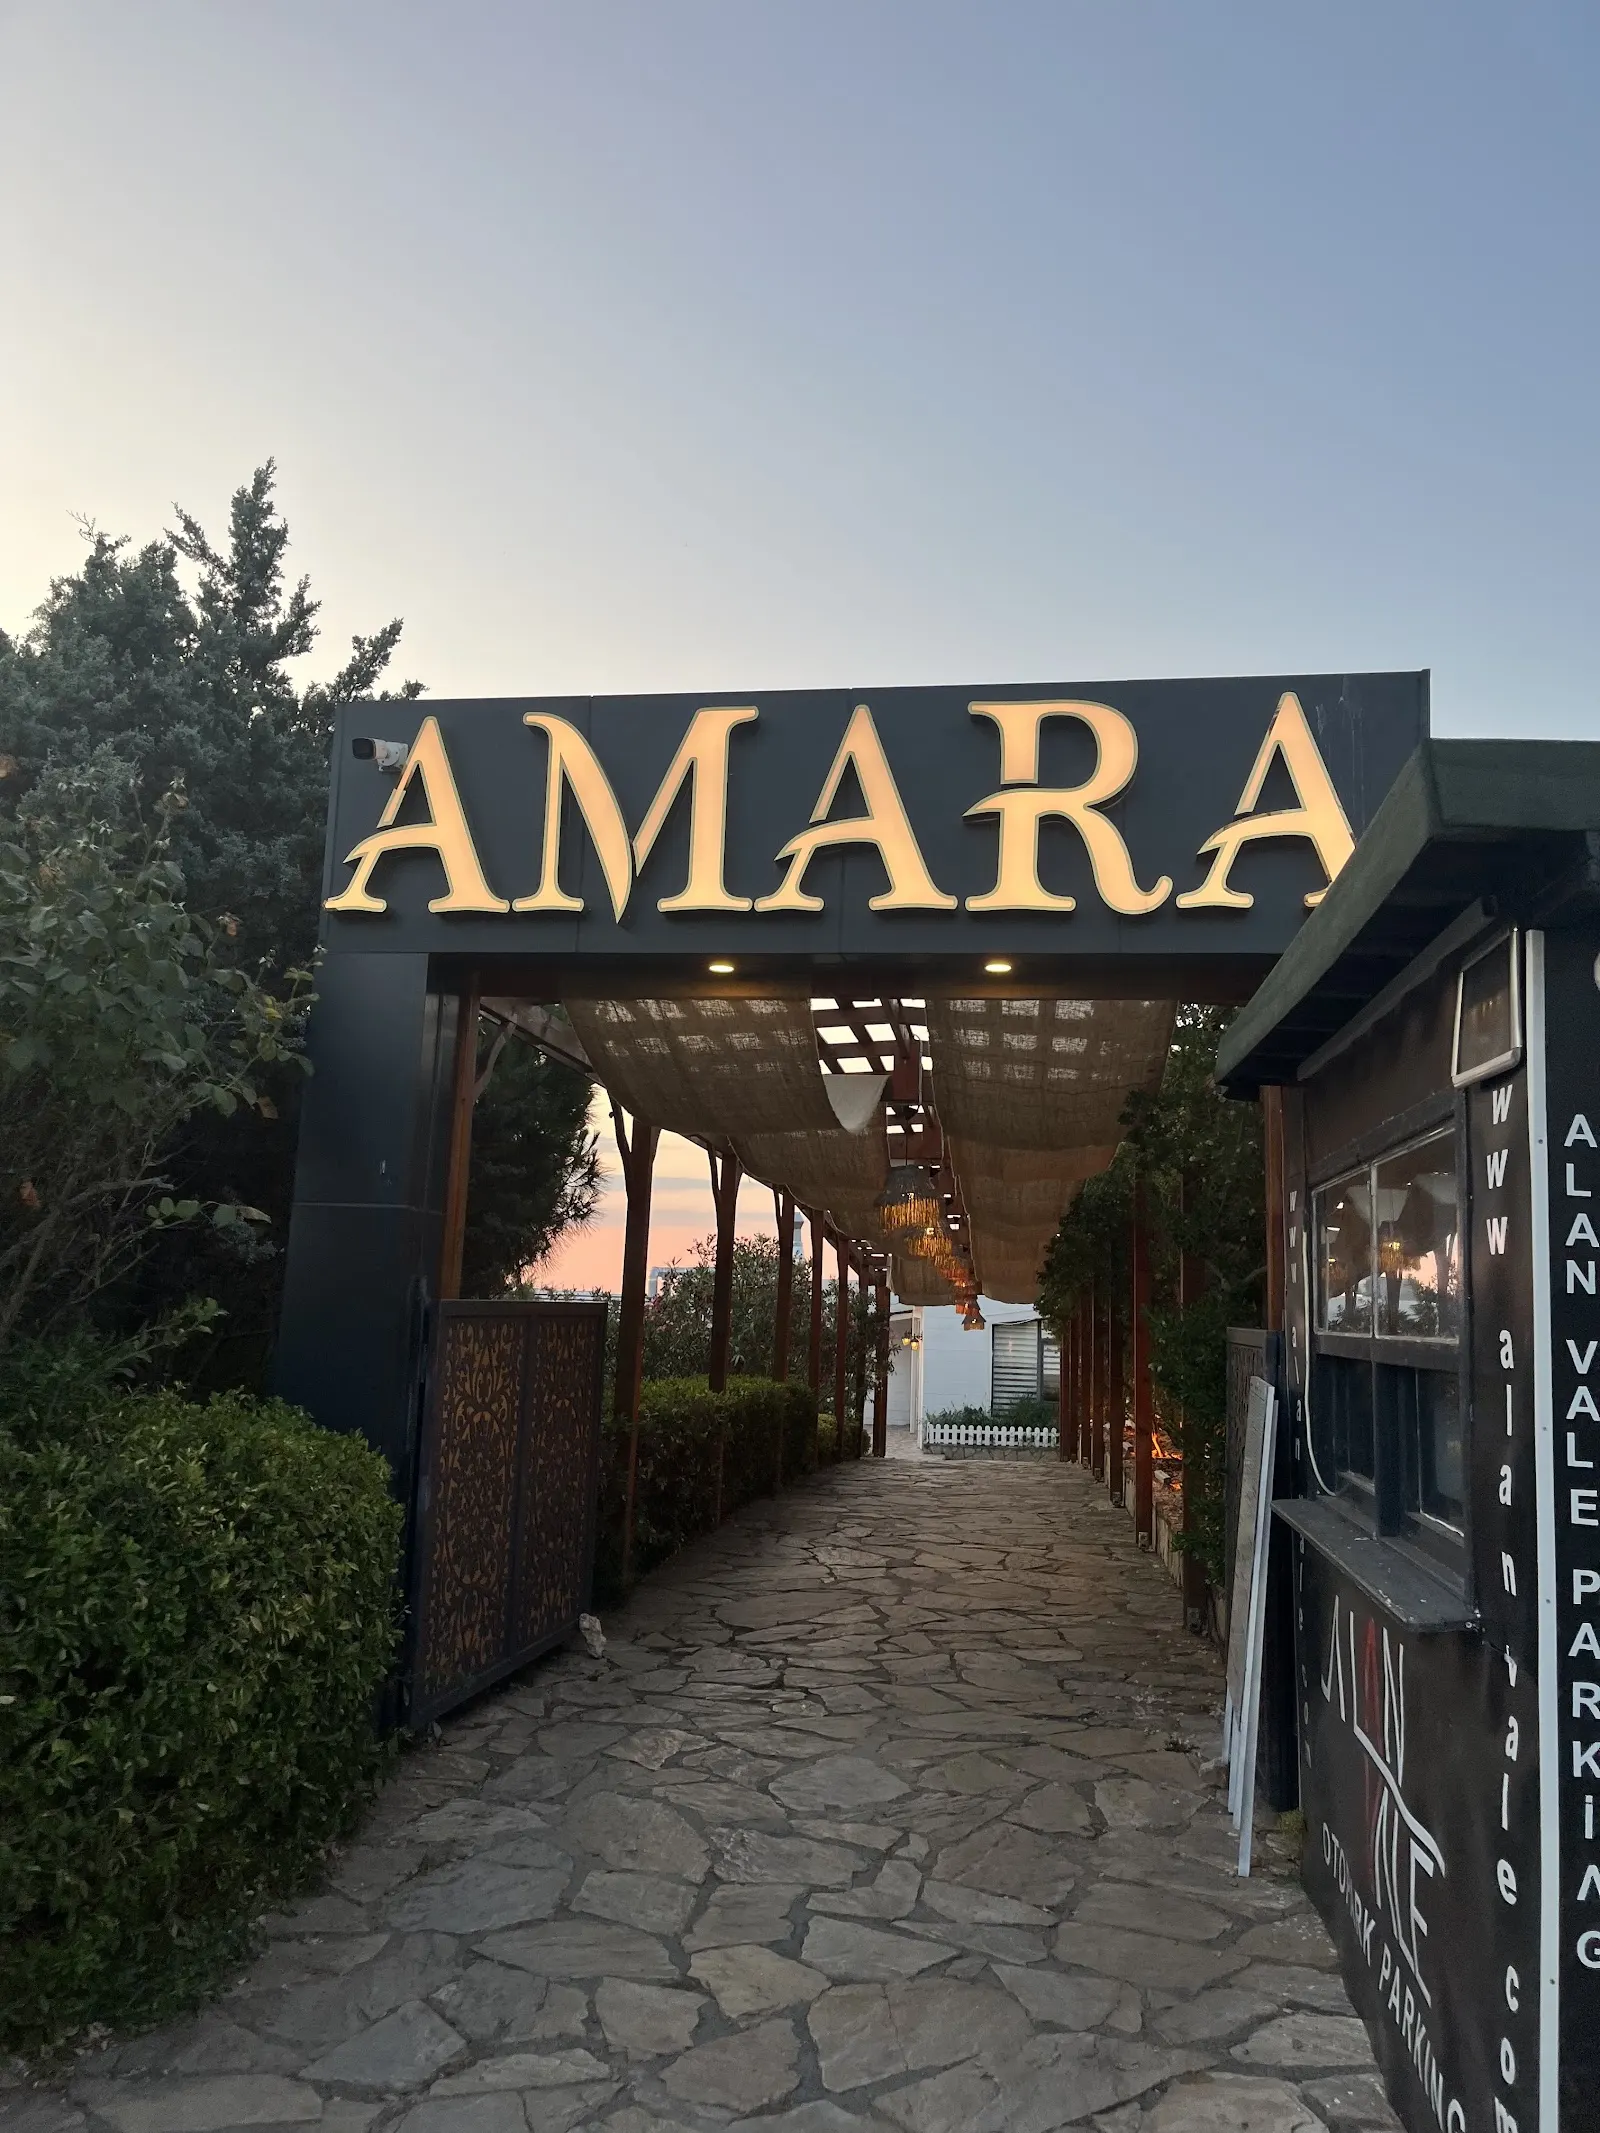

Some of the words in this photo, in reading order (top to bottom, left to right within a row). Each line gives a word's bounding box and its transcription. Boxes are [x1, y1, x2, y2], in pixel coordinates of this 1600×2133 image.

[322, 691, 1356, 923] AMARA
[1564, 1114, 1600, 1295] ALAN
[1565, 1339, 1600, 1526] VALE
